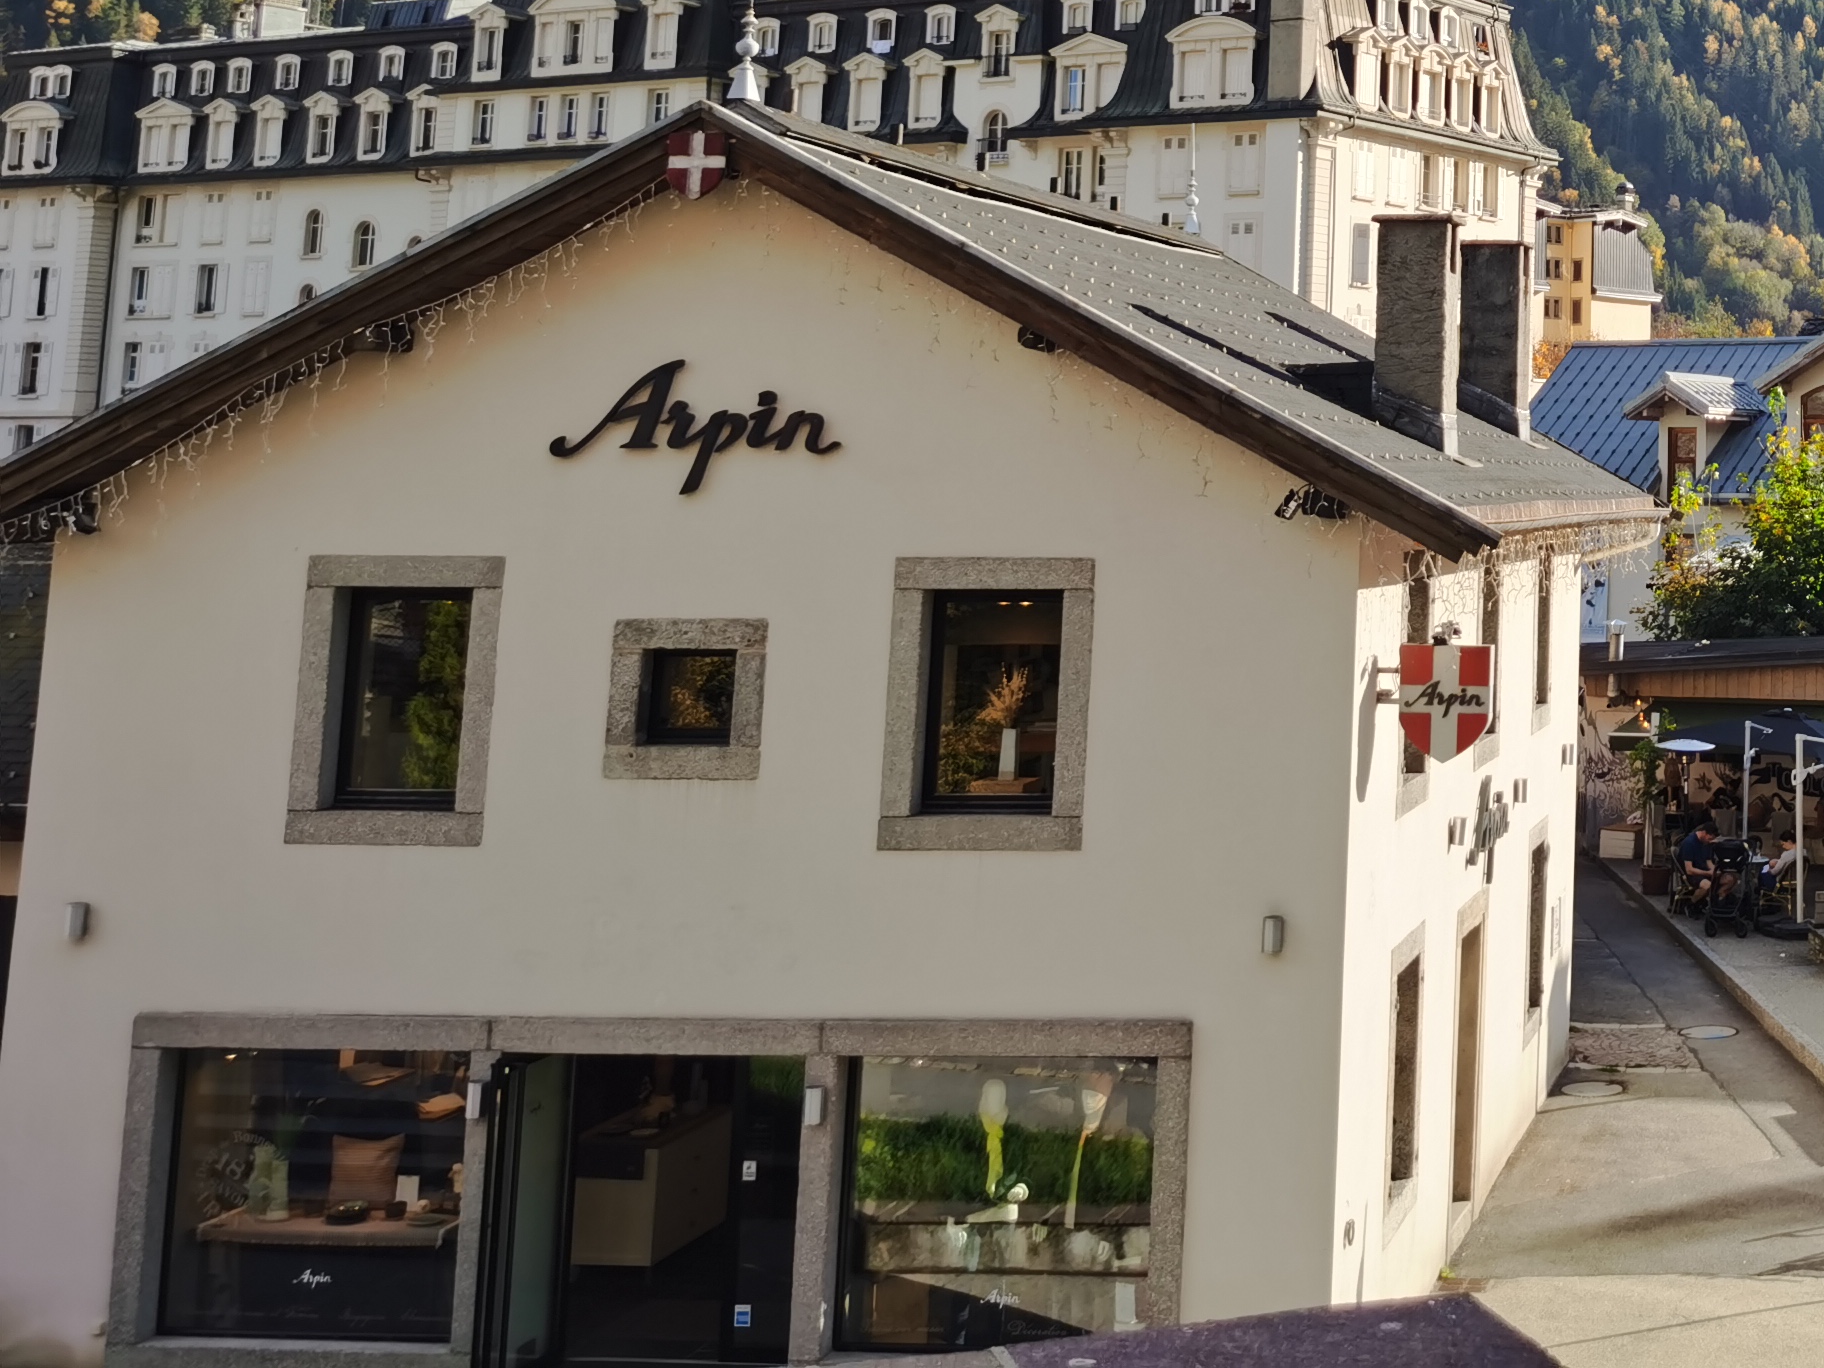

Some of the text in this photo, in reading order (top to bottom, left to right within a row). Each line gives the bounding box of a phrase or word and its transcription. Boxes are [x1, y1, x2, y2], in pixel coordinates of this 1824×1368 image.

[549, 358, 844, 496] Arpin
[1404, 680, 1485, 719] Arpin
[292, 1268, 333, 1290] Arpin
[980, 1288, 1021, 1309] Arpin
